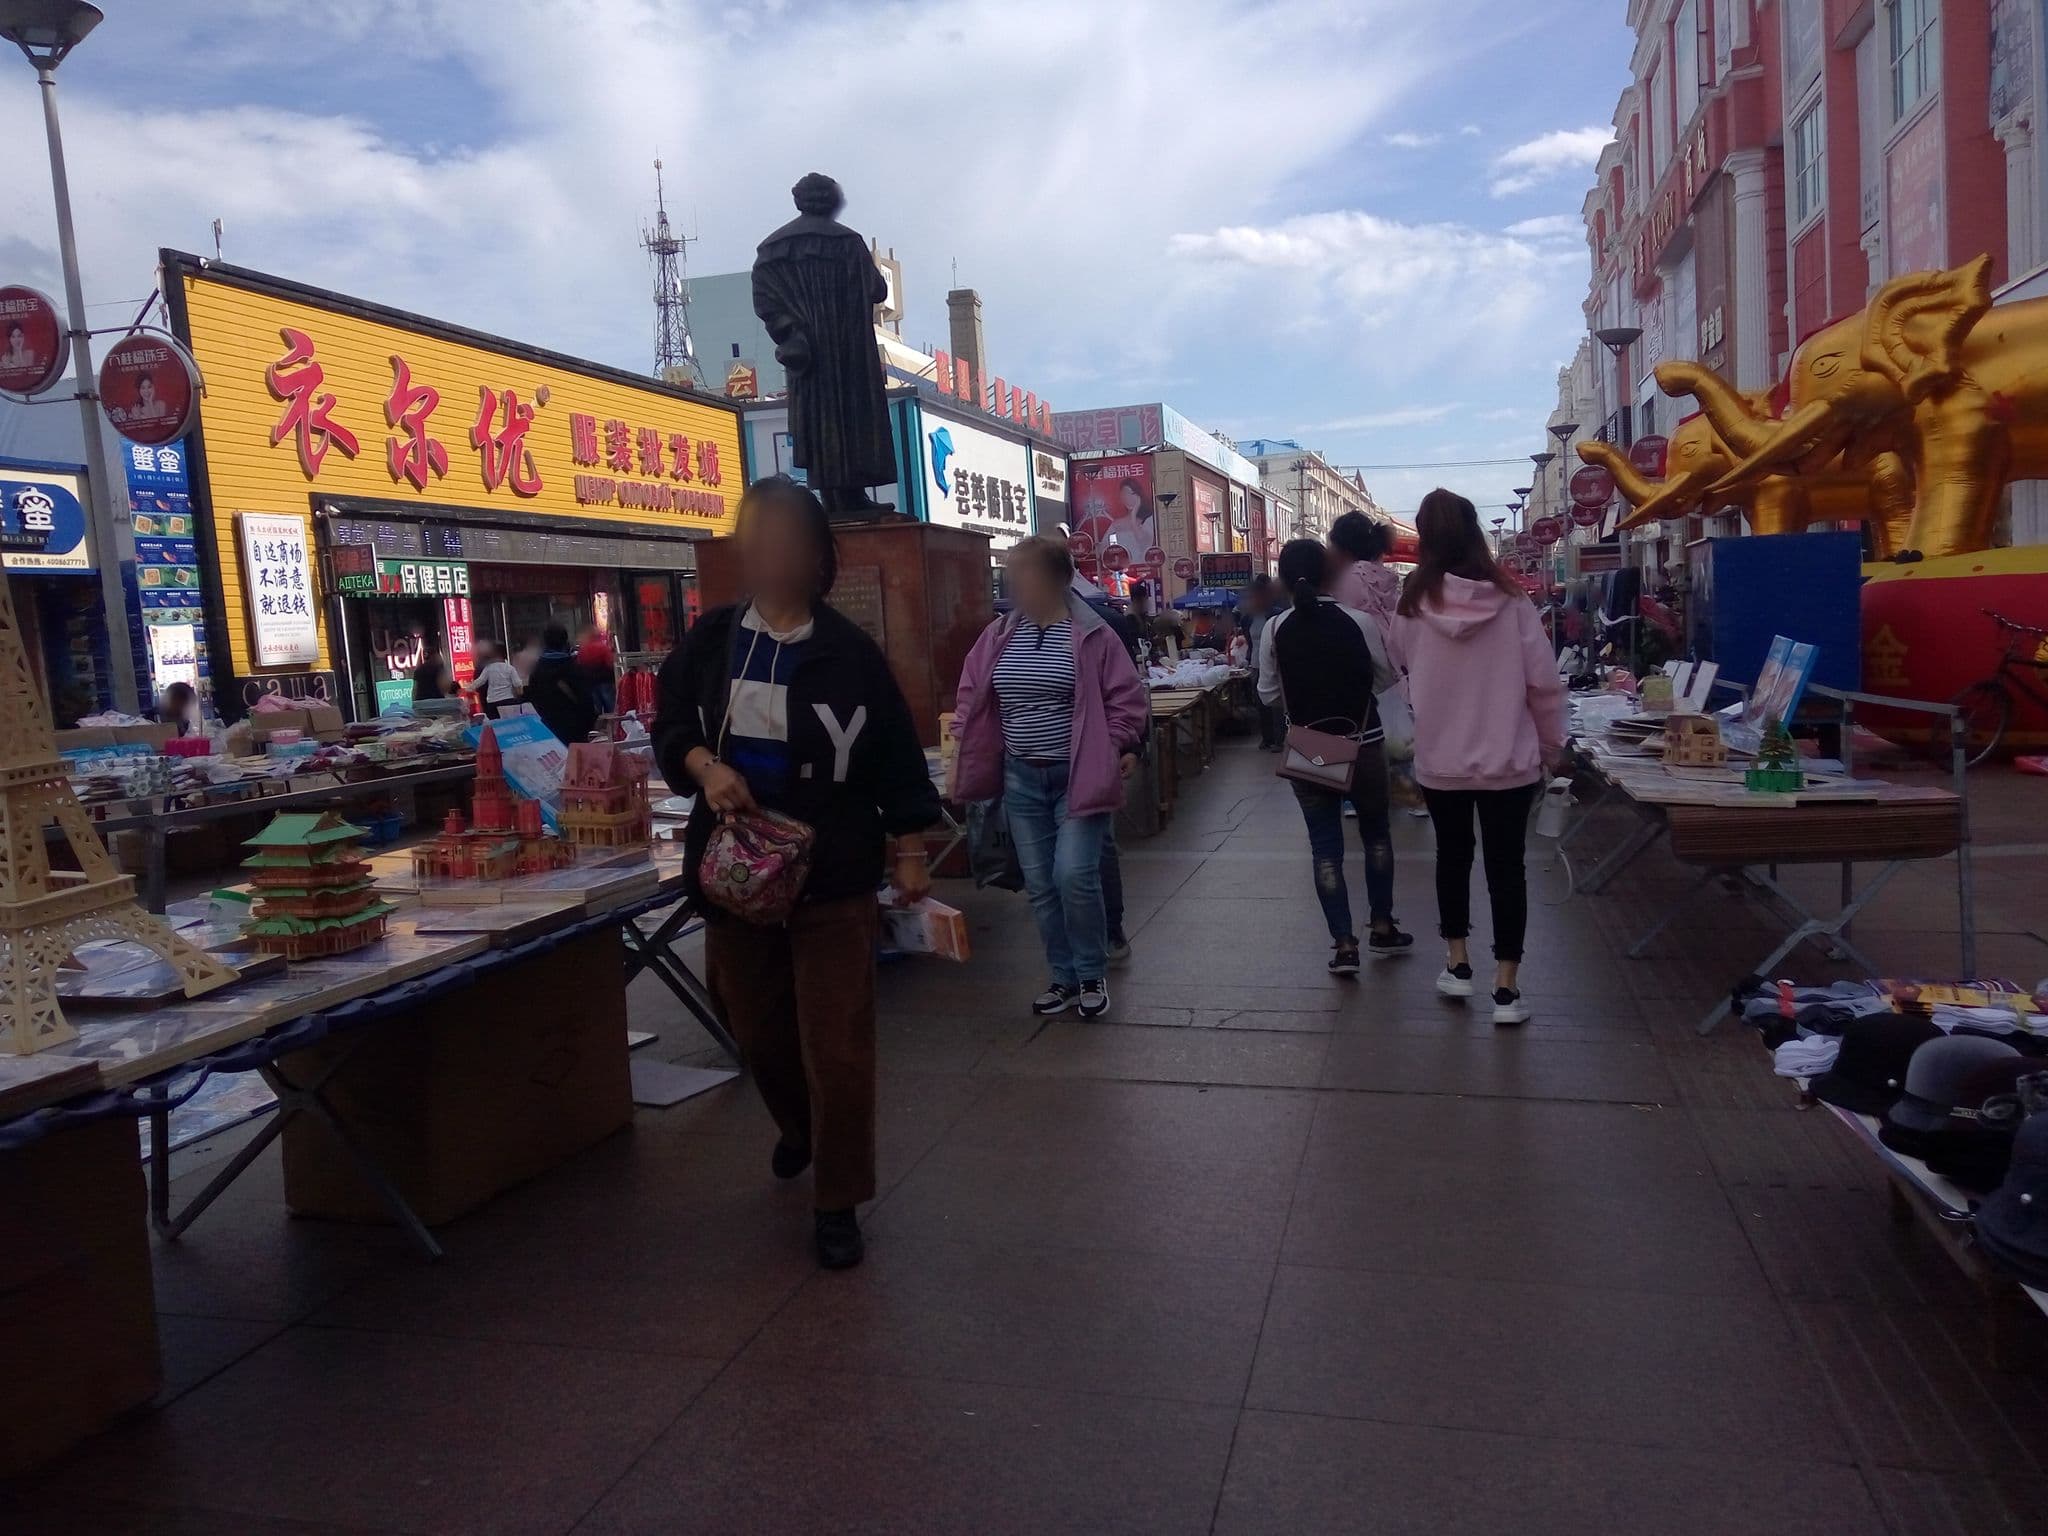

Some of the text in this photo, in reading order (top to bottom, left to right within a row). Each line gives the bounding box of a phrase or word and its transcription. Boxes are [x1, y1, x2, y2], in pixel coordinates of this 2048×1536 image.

[265, 328, 544, 498] 衣尔优
[570, 412, 722, 488] 服装批发城
[0, 487, 56, 530] 蜜
[253, 540, 303, 566] 自选商场
[259, 567, 305, 591] 不满意
[401, 564, 469, 594] 保健品店
[259, 593, 310, 618] 就退钱
[1868, 624, 1912, 687] 金
